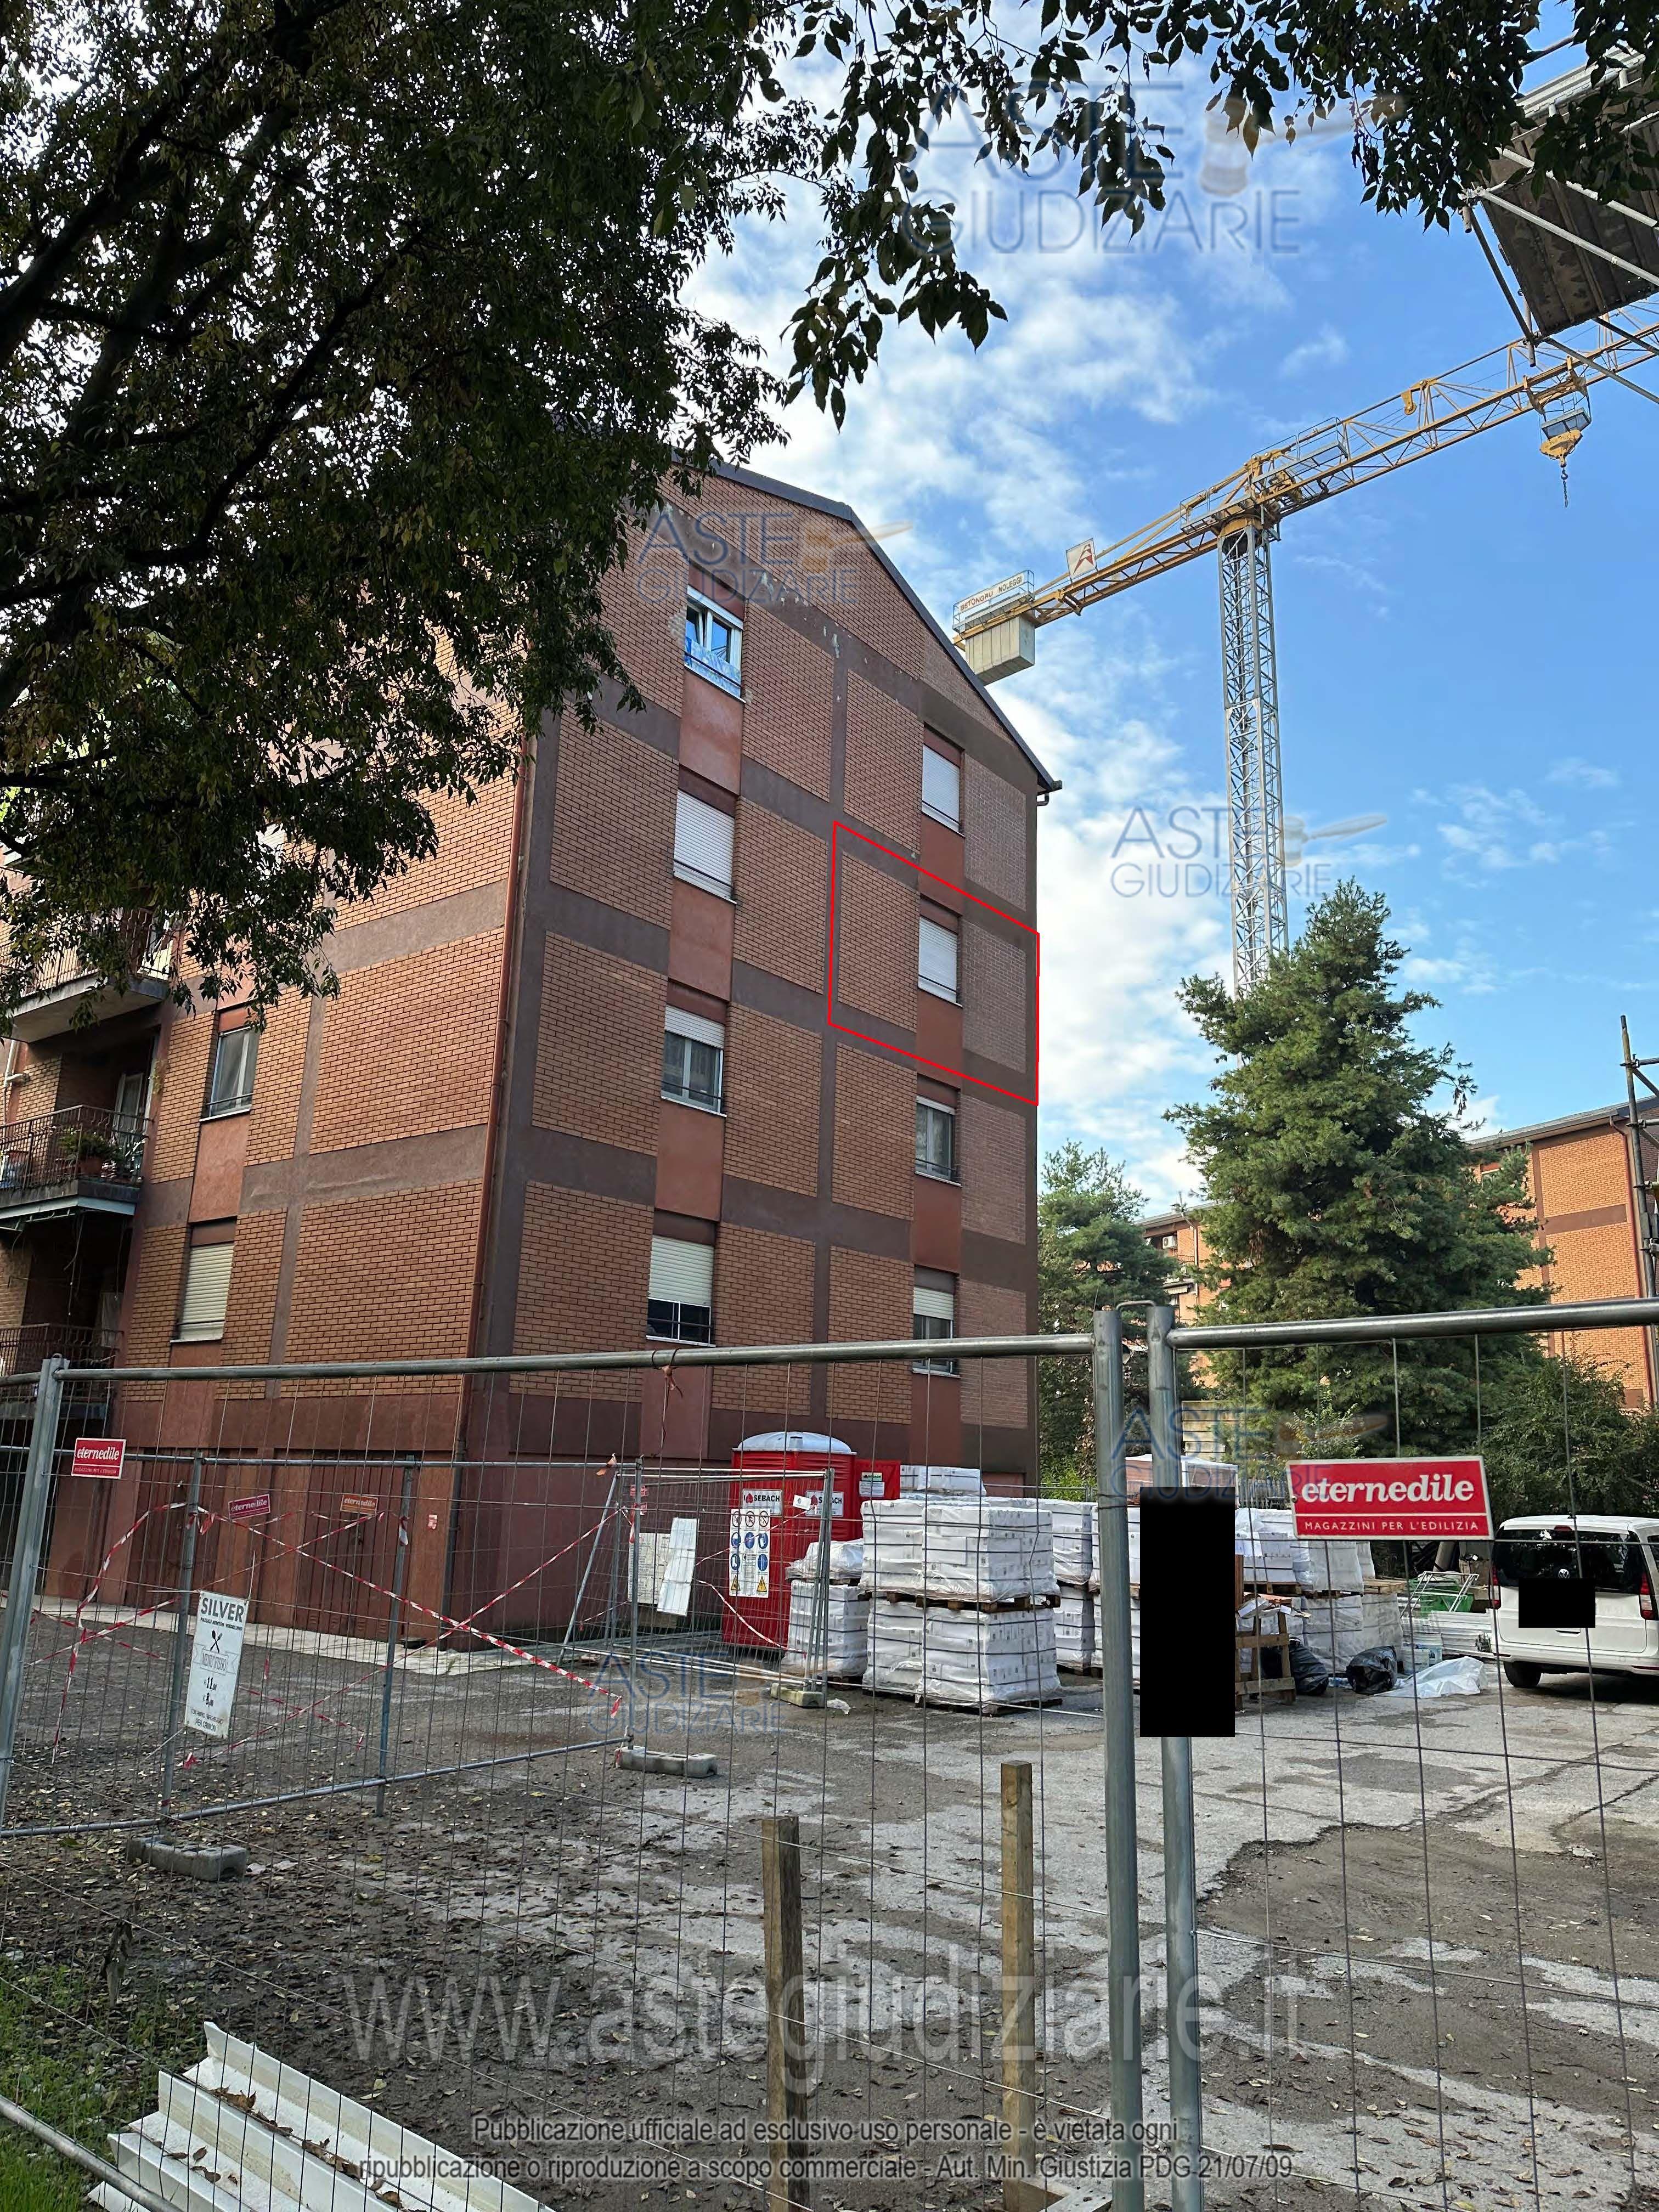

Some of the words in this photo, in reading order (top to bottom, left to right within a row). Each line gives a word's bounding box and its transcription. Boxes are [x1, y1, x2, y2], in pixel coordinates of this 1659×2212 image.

[960, 591, 994, 611] BETONGRU
[998, 575, 1022, 592] NOLEGGI
[77, 1447, 119, 1460] eternedile
[1301, 1474, 1475, 1503] eternedile
[1305, 1521, 1375, 1531] MAGAZZINI
[1382, 1521, 1404, 1531] PER
[1410, 1521, 1479, 1531] L'EDILIZIA
[201, 1597, 244, 1622] SILVER
